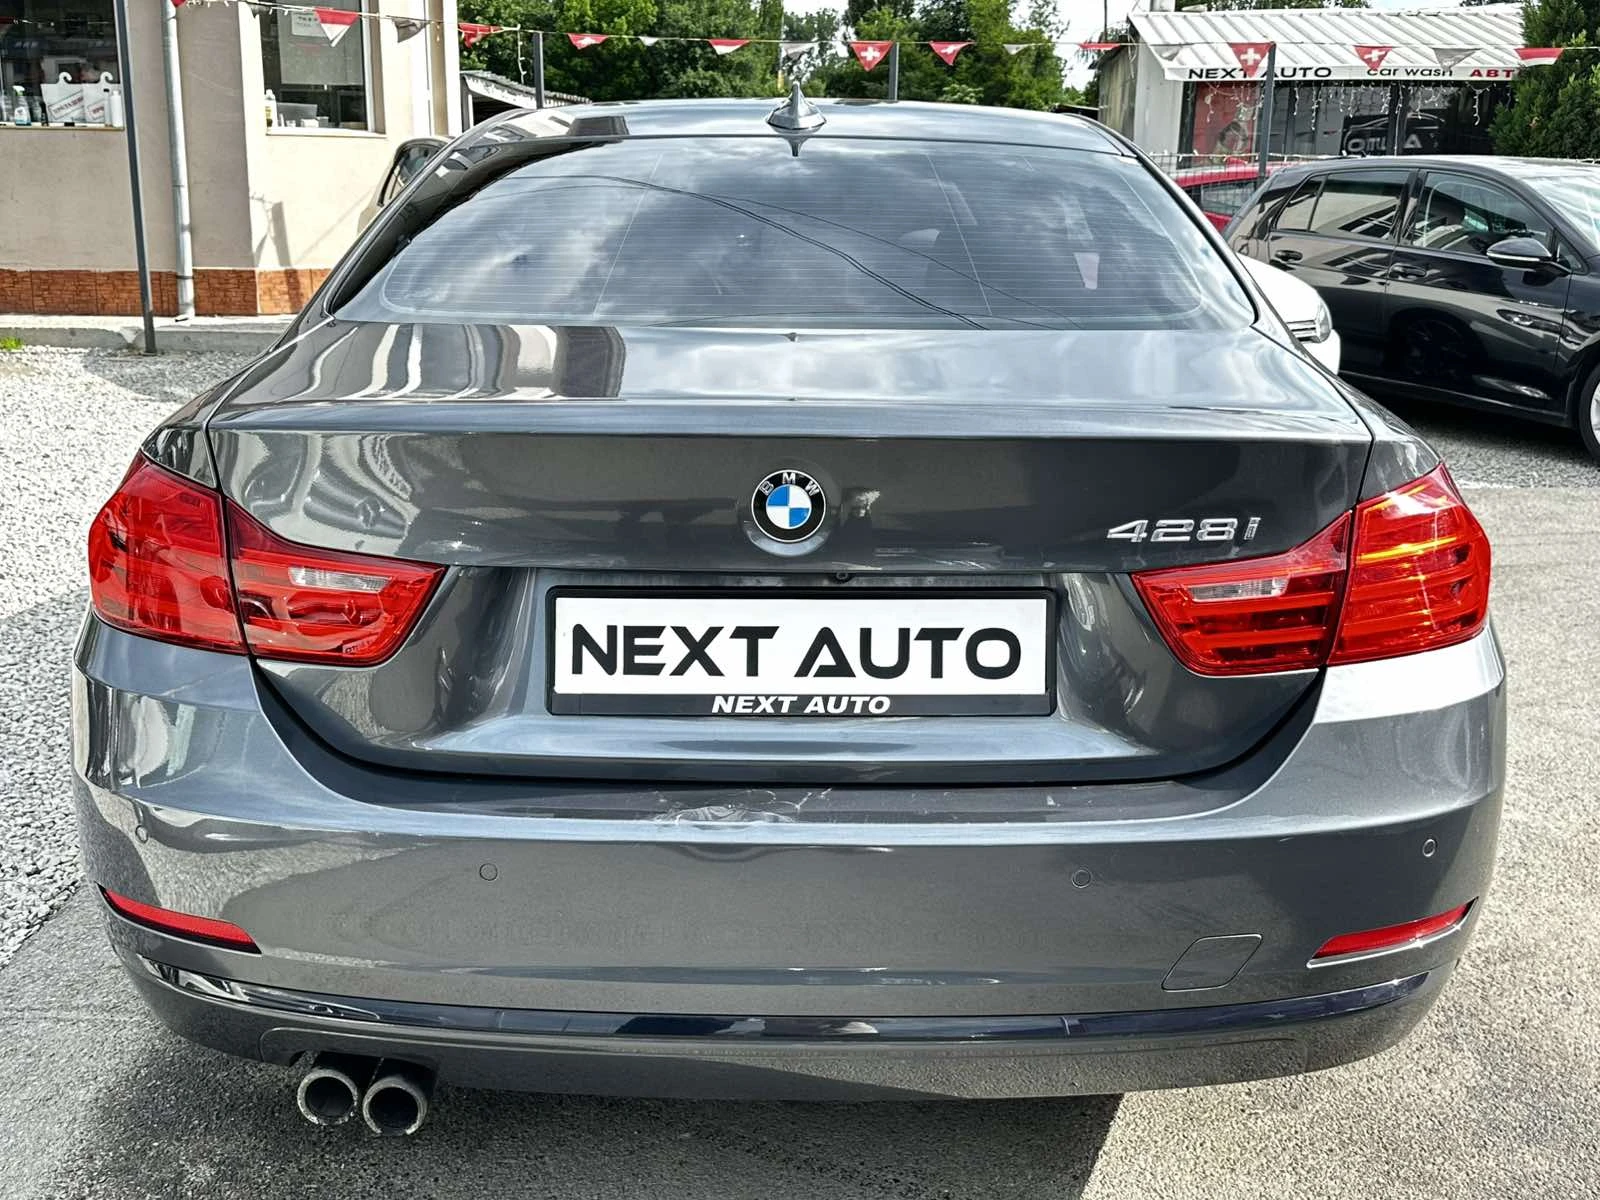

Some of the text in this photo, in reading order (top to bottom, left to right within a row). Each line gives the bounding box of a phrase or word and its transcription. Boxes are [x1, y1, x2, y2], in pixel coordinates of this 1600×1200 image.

[1366, 67, 1399, 77] car
[759, 471, 820, 496] BMW
[1106, 516, 1261, 543] 428i
[572, 624, 1021, 679] NEXT AUTO
[711, 695, 892, 714] NEXT AUTO
